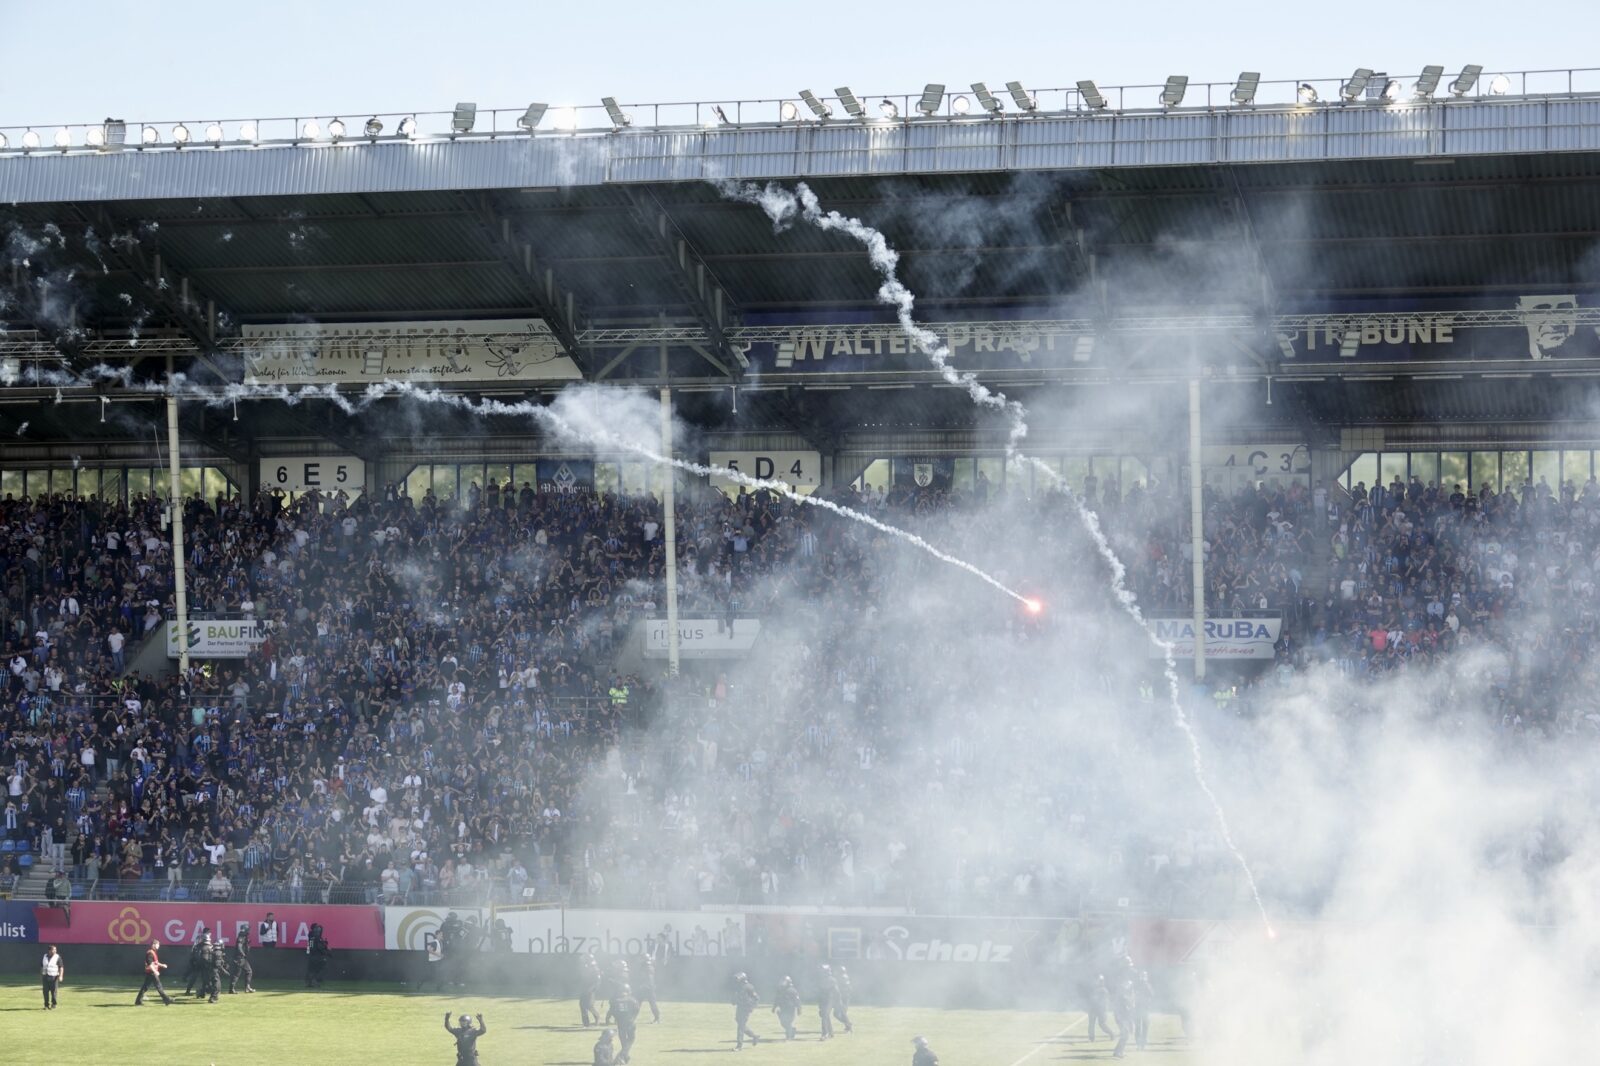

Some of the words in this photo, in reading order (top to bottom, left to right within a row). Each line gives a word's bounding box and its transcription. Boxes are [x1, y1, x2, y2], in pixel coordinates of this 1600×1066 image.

[276, 465, 288, 484] 6
[303, 463, 321, 486] E
[336, 465, 347, 483] 5
[755, 456, 775, 480] D
[790, 459, 802, 477] 4
[1247, 450, 1269, 475] C
[1280, 453, 1291, 472] 3
